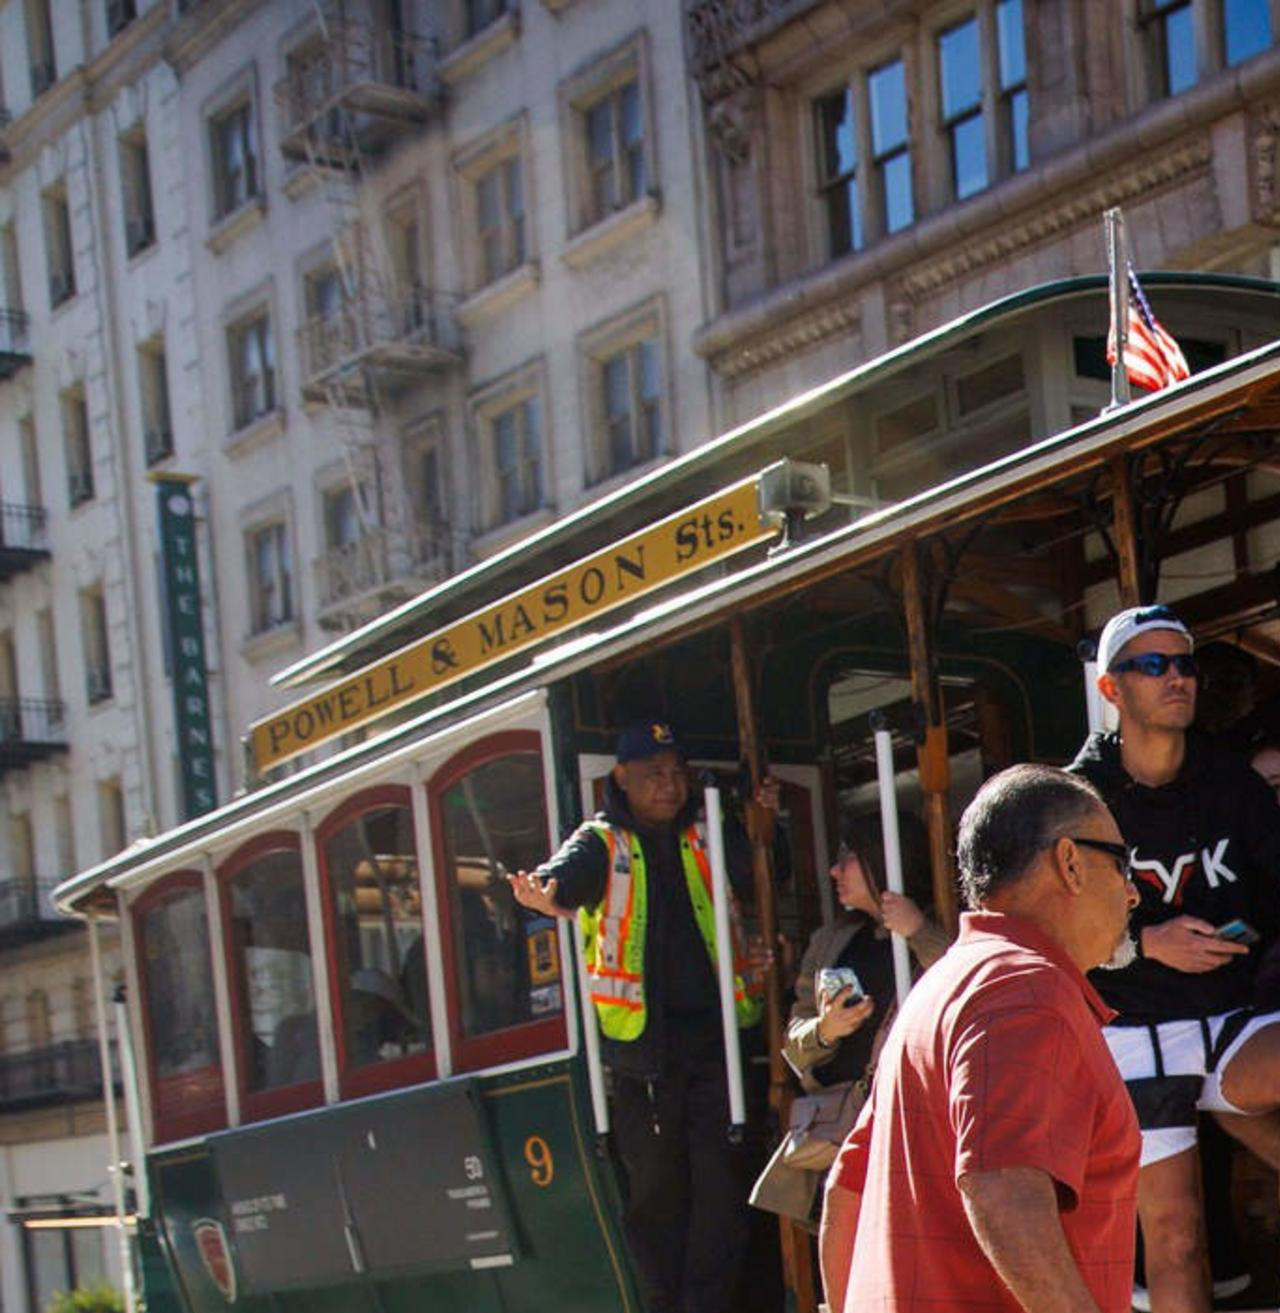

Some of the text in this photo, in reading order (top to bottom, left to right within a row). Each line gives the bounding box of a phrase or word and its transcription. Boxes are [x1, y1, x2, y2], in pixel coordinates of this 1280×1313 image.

[174, 535, 196, 616] THE
[267, 504, 746, 752] POWELL & MASON Sts.
[523, 1135, 555, 1187] 9
